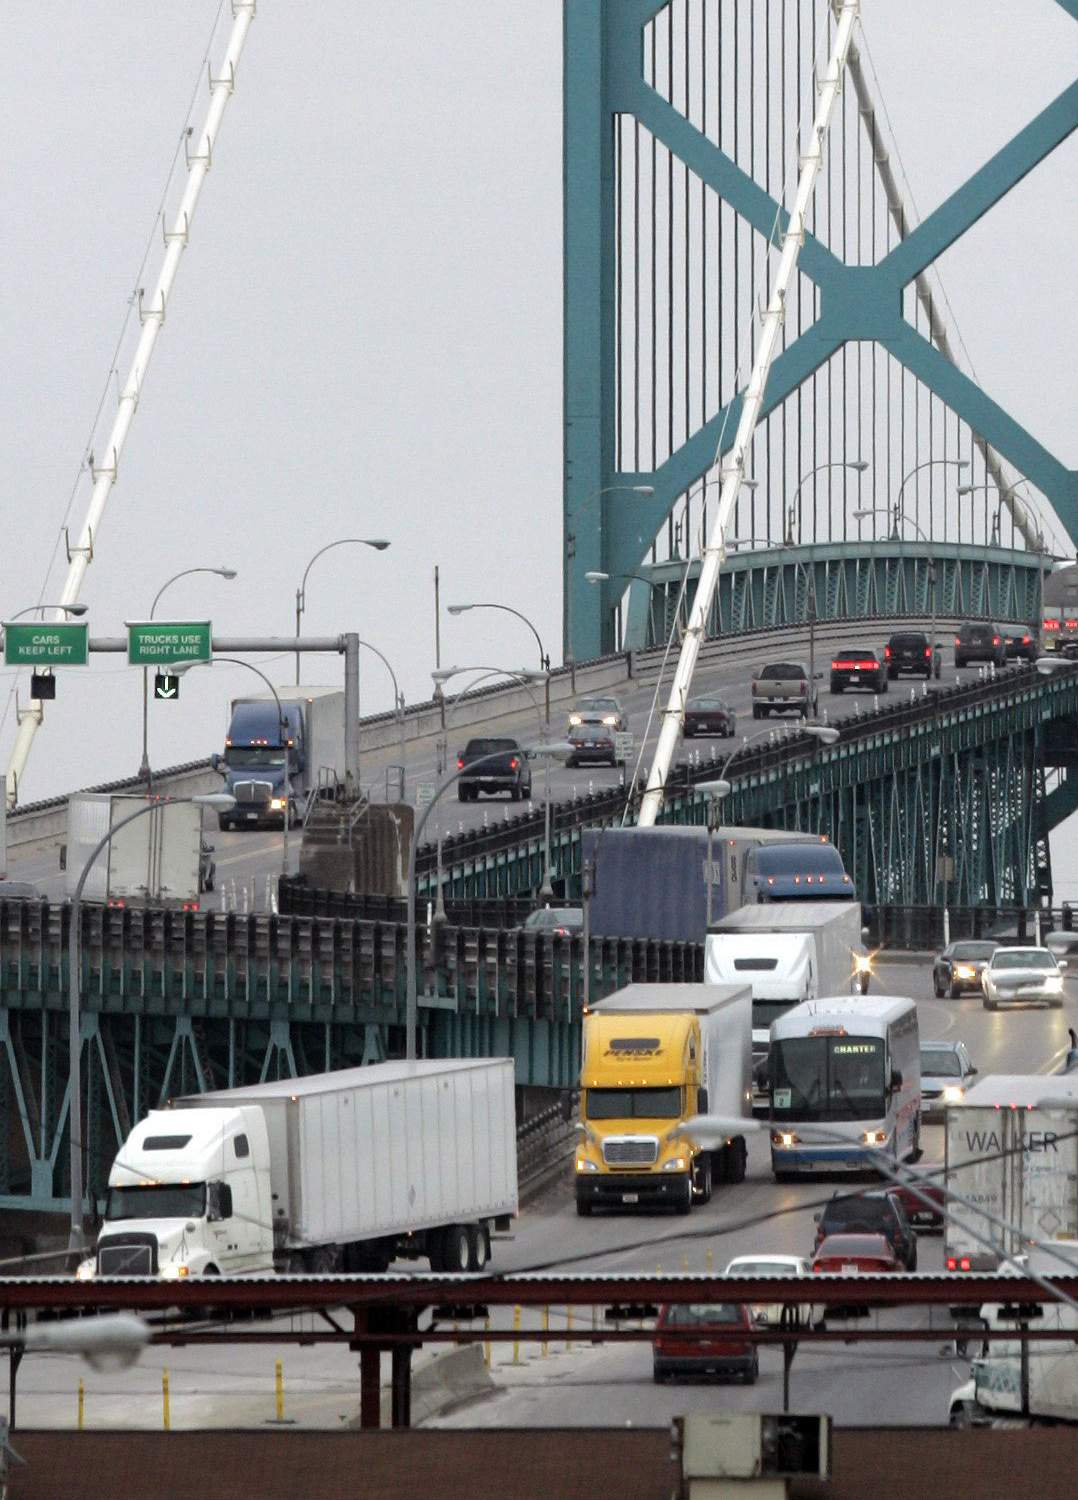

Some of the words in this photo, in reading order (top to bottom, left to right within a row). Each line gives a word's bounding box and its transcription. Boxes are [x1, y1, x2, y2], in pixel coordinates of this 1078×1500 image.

[32, 635, 60, 644] CARS
[138, 635, 179, 644] TRUCKS
[181, 635, 201, 644] USE
[19, 646, 46, 655] KEEP
[48, 646, 72, 655] LEFT
[139, 646, 170, 655] RIGHT
[173, 646, 200, 655] LANE
[834, 1044, 876, 1054] CHARTER
